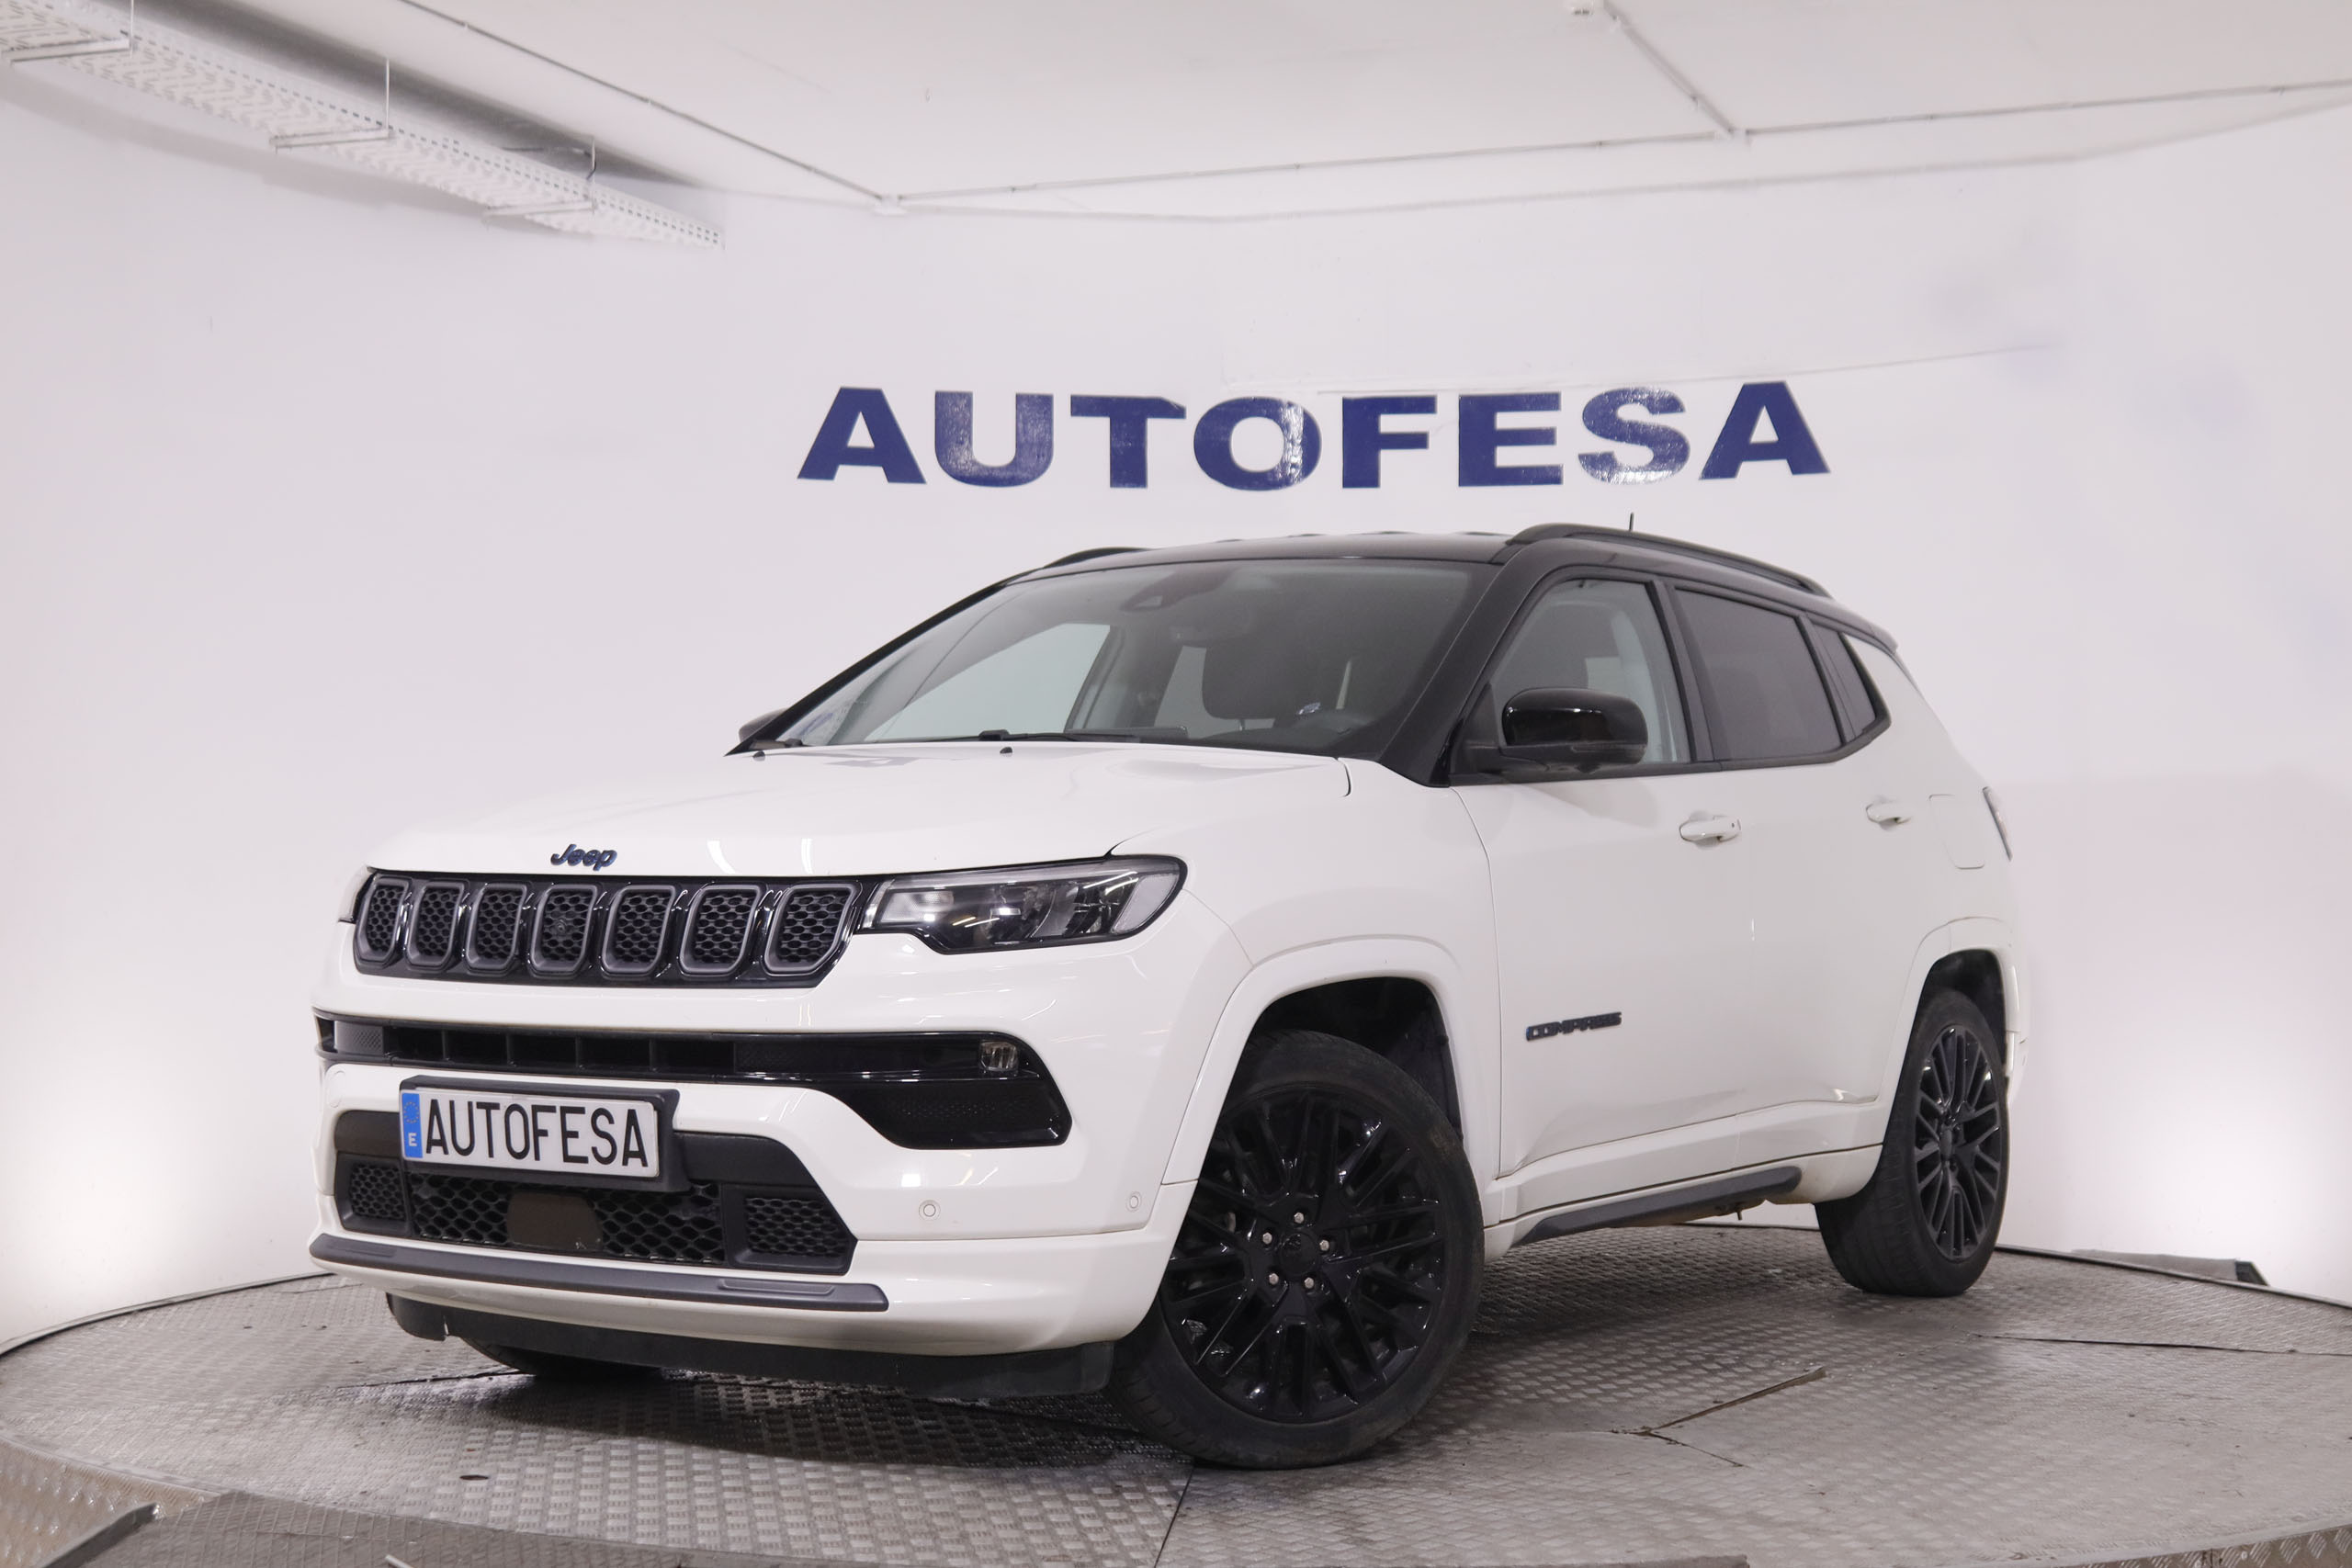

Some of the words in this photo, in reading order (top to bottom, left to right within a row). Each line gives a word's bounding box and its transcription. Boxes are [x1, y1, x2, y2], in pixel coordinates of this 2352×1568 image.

[797, 381, 1831, 491] AUTOFESA
[550, 843, 617, 872] Jeep
[408, 1132, 418, 1147] E
[425, 1099, 649, 1168] AUTOFESA
